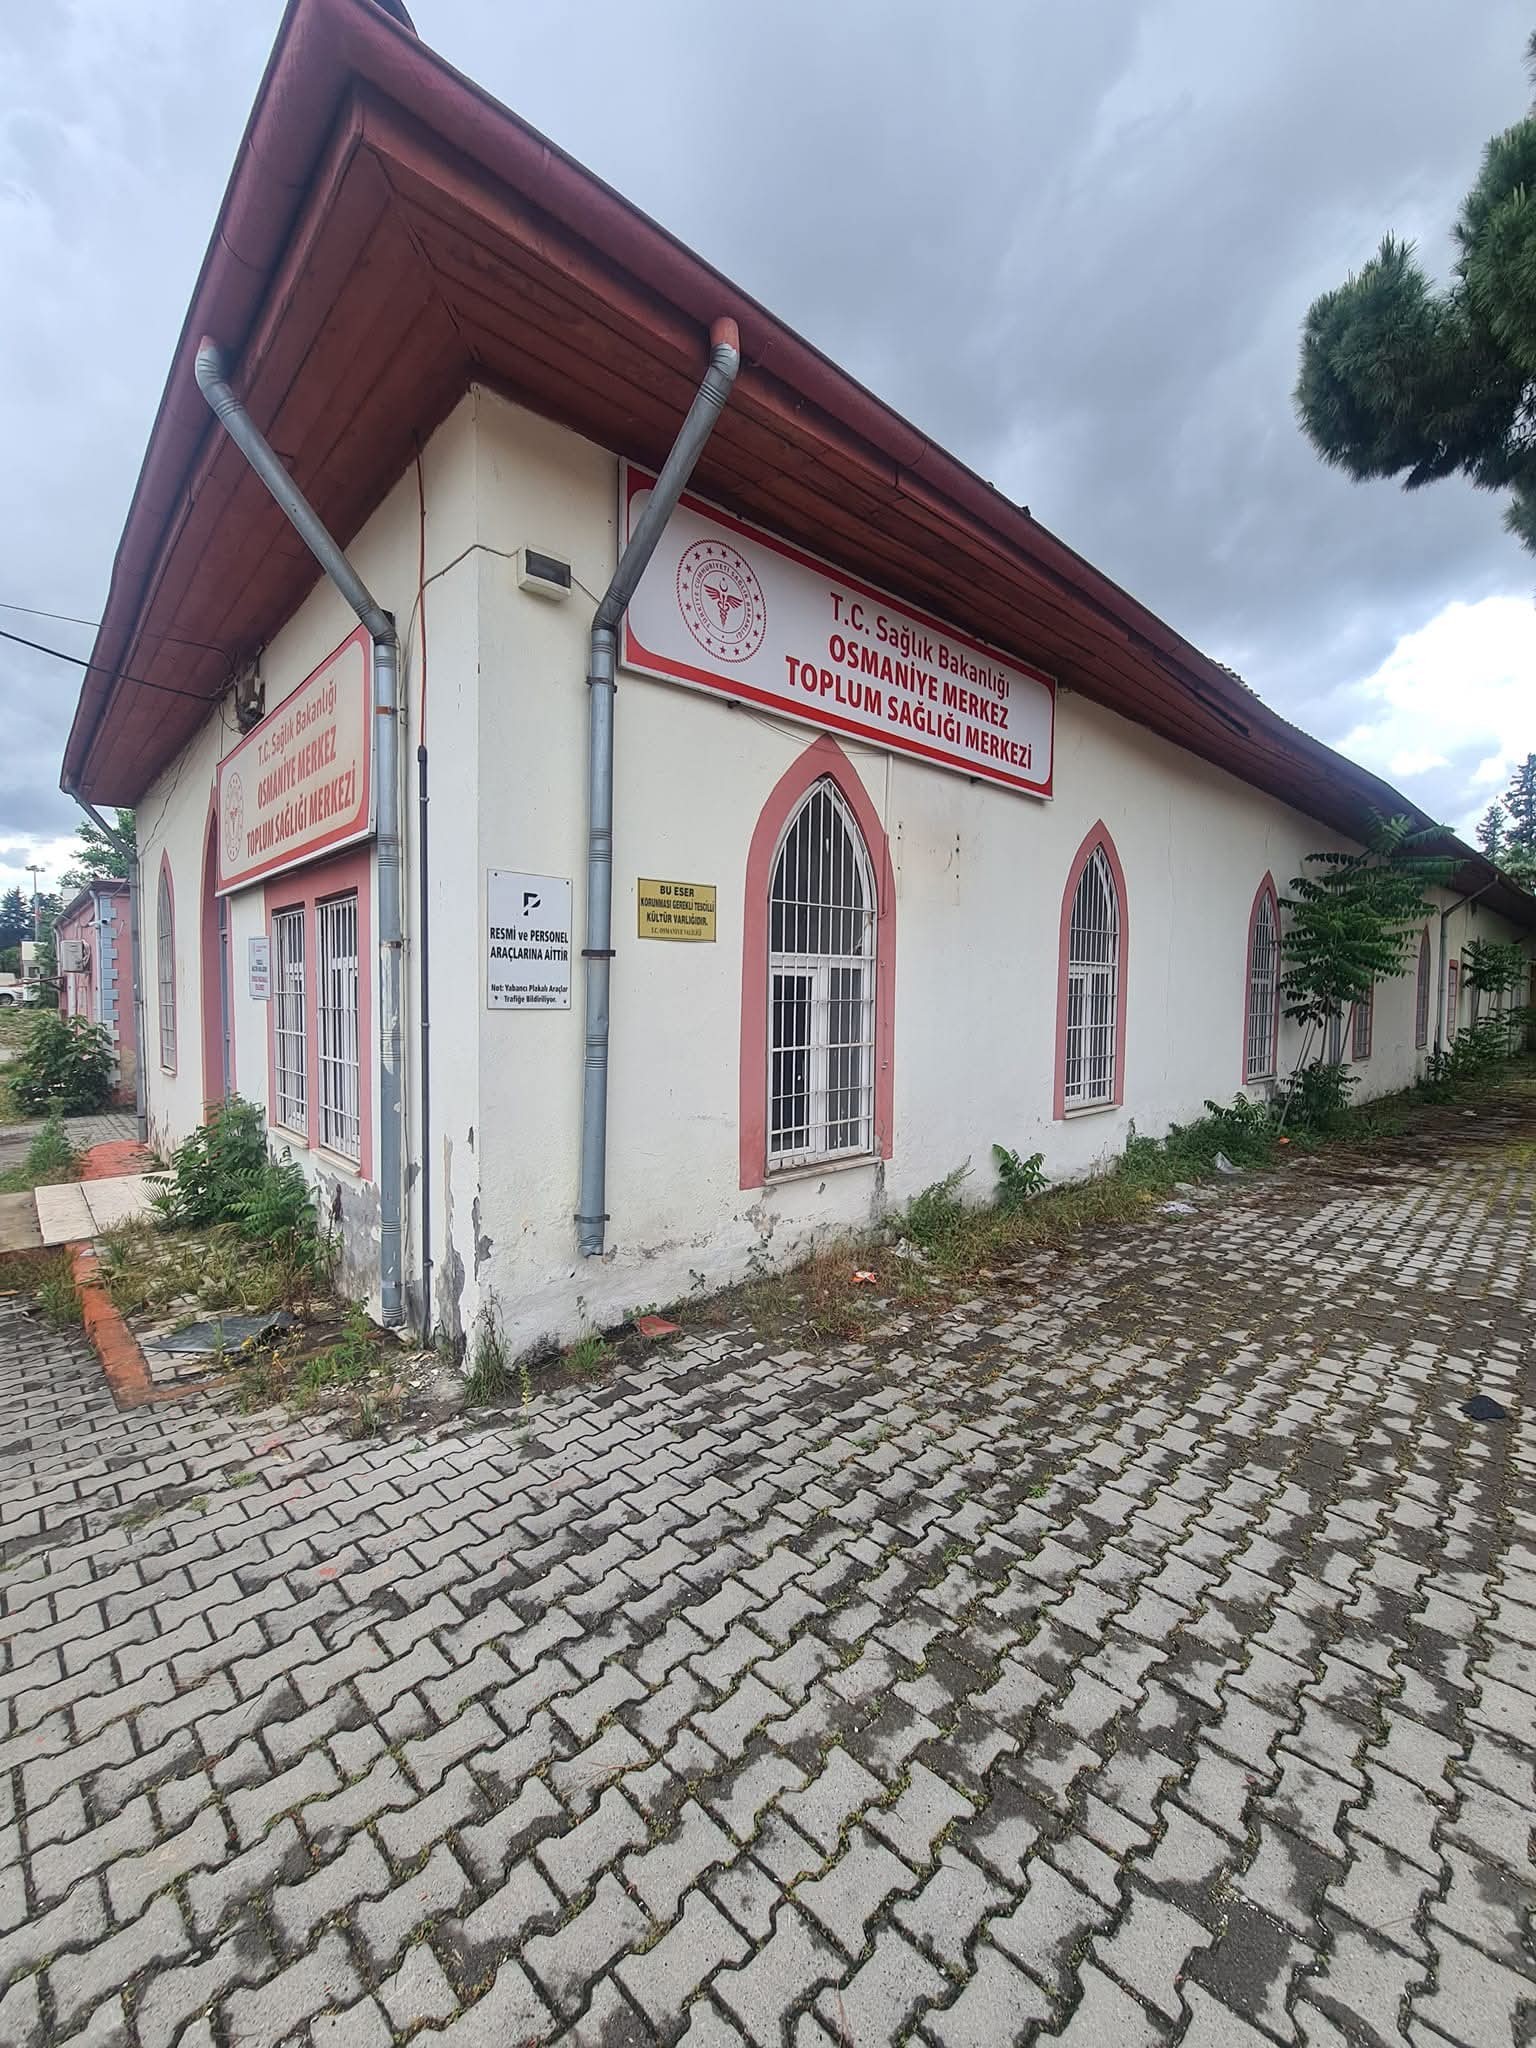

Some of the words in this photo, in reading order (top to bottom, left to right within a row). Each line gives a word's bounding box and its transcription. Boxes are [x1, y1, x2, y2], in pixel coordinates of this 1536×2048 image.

[829, 634, 938, 700] OSMANİYE
[943, 682, 1009, 730] MERKEZ
[830, 592, 870, 635] T.C.
[876, 615, 933, 664] Sağlık
[938, 644, 1010, 700] Bakanlığı
[257, 739, 271, 767] T.C.
[271, 725, 294, 754] Sağlık
[295, 681, 337, 737] Bakanlığı
[785, 655, 882, 716] TOPLUM
[887, 696, 961, 744] SAĞLIĞI
[965, 725, 1032, 770] MERKEZİ
[247, 824, 274, 859] TOPLUM
[275, 792, 307, 844] SAĞLIĞI
[309, 760, 356, 825] MERKEZİ
[257, 755, 296, 810] OSMANİYE
[298, 724, 337, 785] MERKEZ
[490, 925, 516, 941] RESMİ
[518, 931, 528, 941] ve
[530, 930, 569, 943] PERSONEL
[646, 911, 672, 923] KÜLTÜR
[660, 885, 672, 895] BU
[674, 886, 694, 897] ESER
[490, 946, 543, 962] ARAÇLARINA
[544, 946, 568, 961] AİTTİR
[491, 984, 504, 992] Not:
[504, 984, 528, 992] Yabancı
